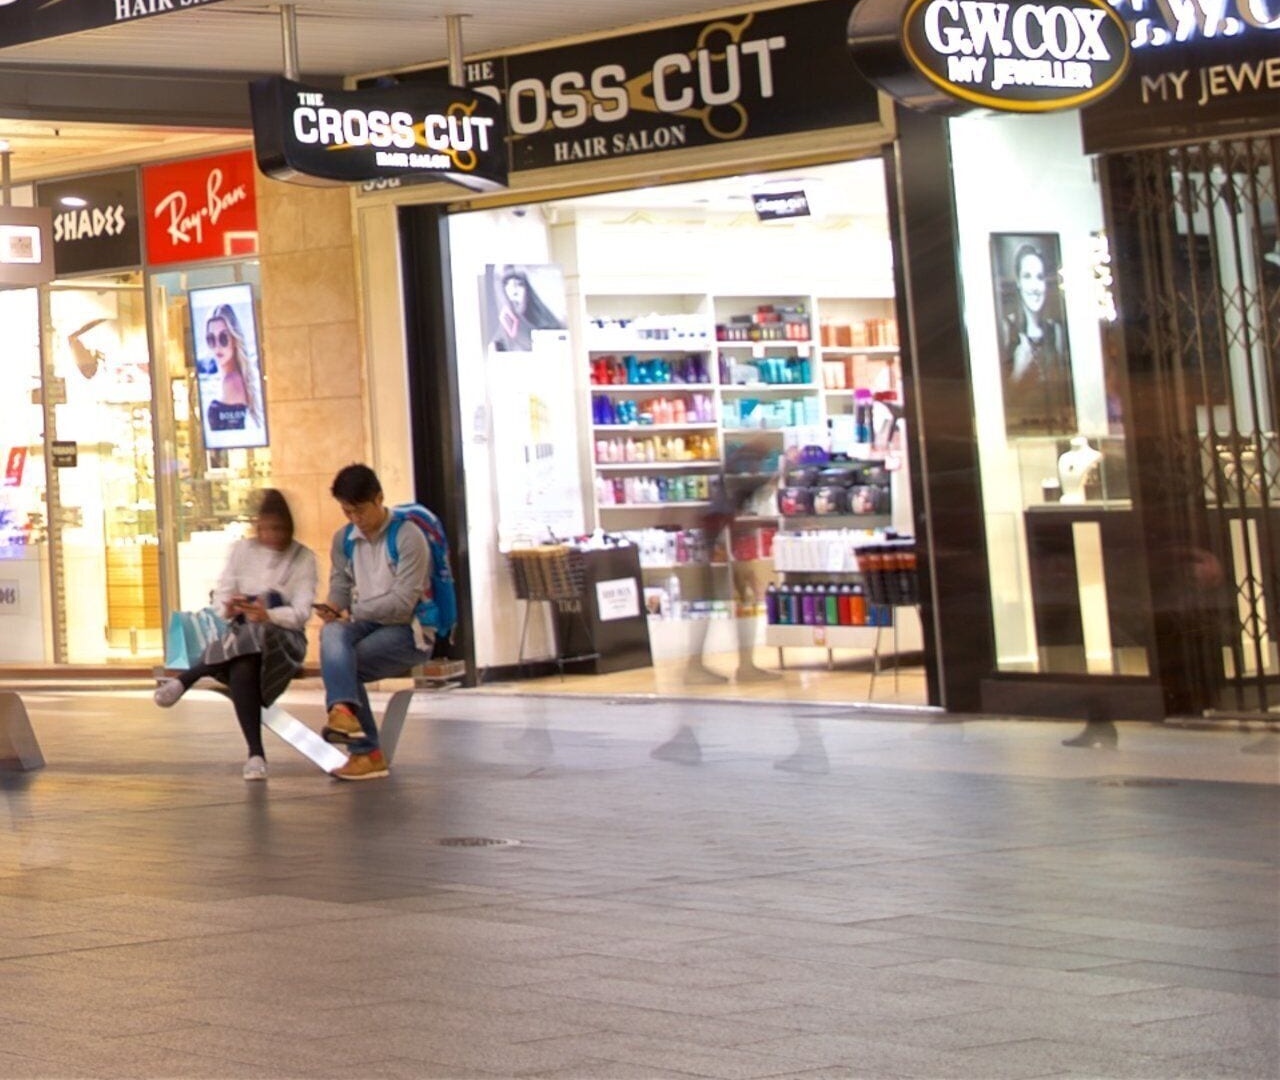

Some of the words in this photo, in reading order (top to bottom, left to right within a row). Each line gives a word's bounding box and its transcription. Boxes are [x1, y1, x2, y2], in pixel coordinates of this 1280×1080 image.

[464, 60, 495, 84] HE
[651, 35, 787, 113] CUT
[947, 56, 987, 84] MY
[991, 58, 1093, 91] JEWELLER
[1141, 70, 1191, 104] MY
[1197, 57, 1280, 107] JEWE
[296, 92, 325, 107] THE
[292, 107, 416, 149] CROSS
[423, 114, 494, 152] CUT
[553, 140, 607, 162] HAIR
[613, 124, 688, 152] SALON
[53, 203, 126, 243] SHADES
